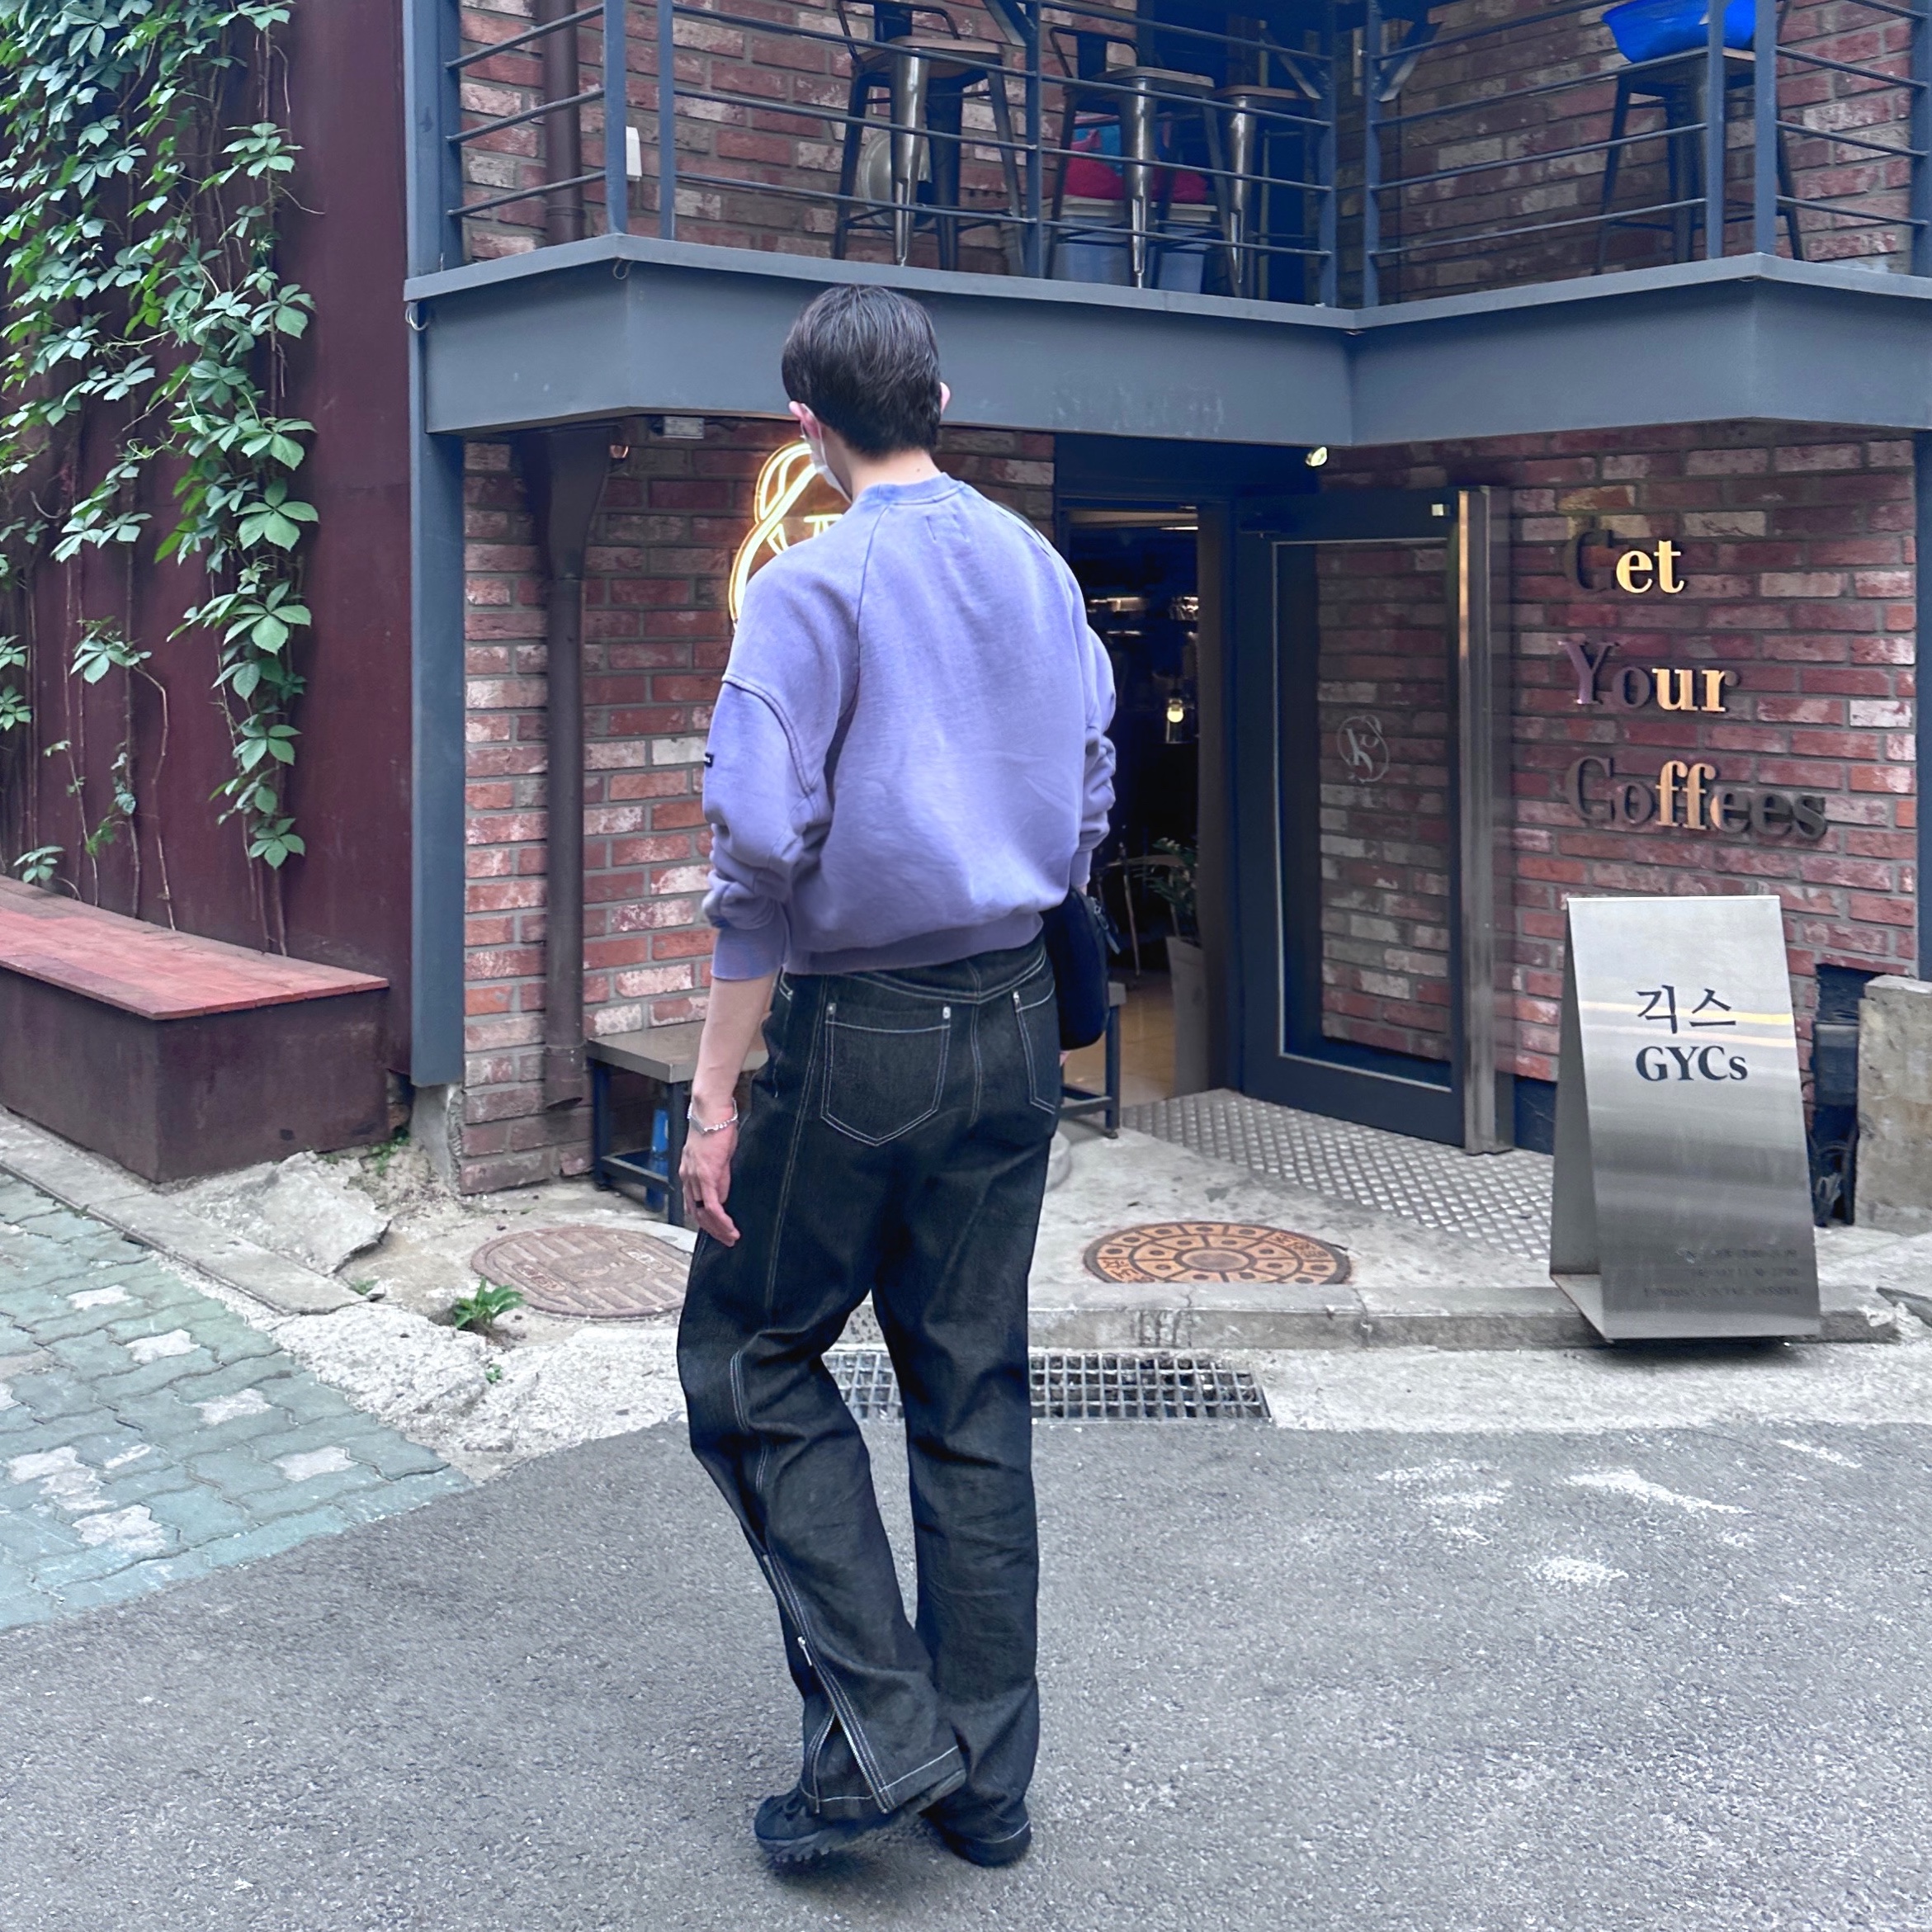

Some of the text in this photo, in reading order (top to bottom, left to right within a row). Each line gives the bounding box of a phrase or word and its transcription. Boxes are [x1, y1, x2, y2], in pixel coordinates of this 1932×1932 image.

[1565, 531, 1684, 594] Get
[1558, 640, 1737, 712] Your
[1571, 757, 1828, 840] Coffees
[1637, 985, 1736, 1034] 긱스
[1636, 1046, 1748, 1081] GYCs
